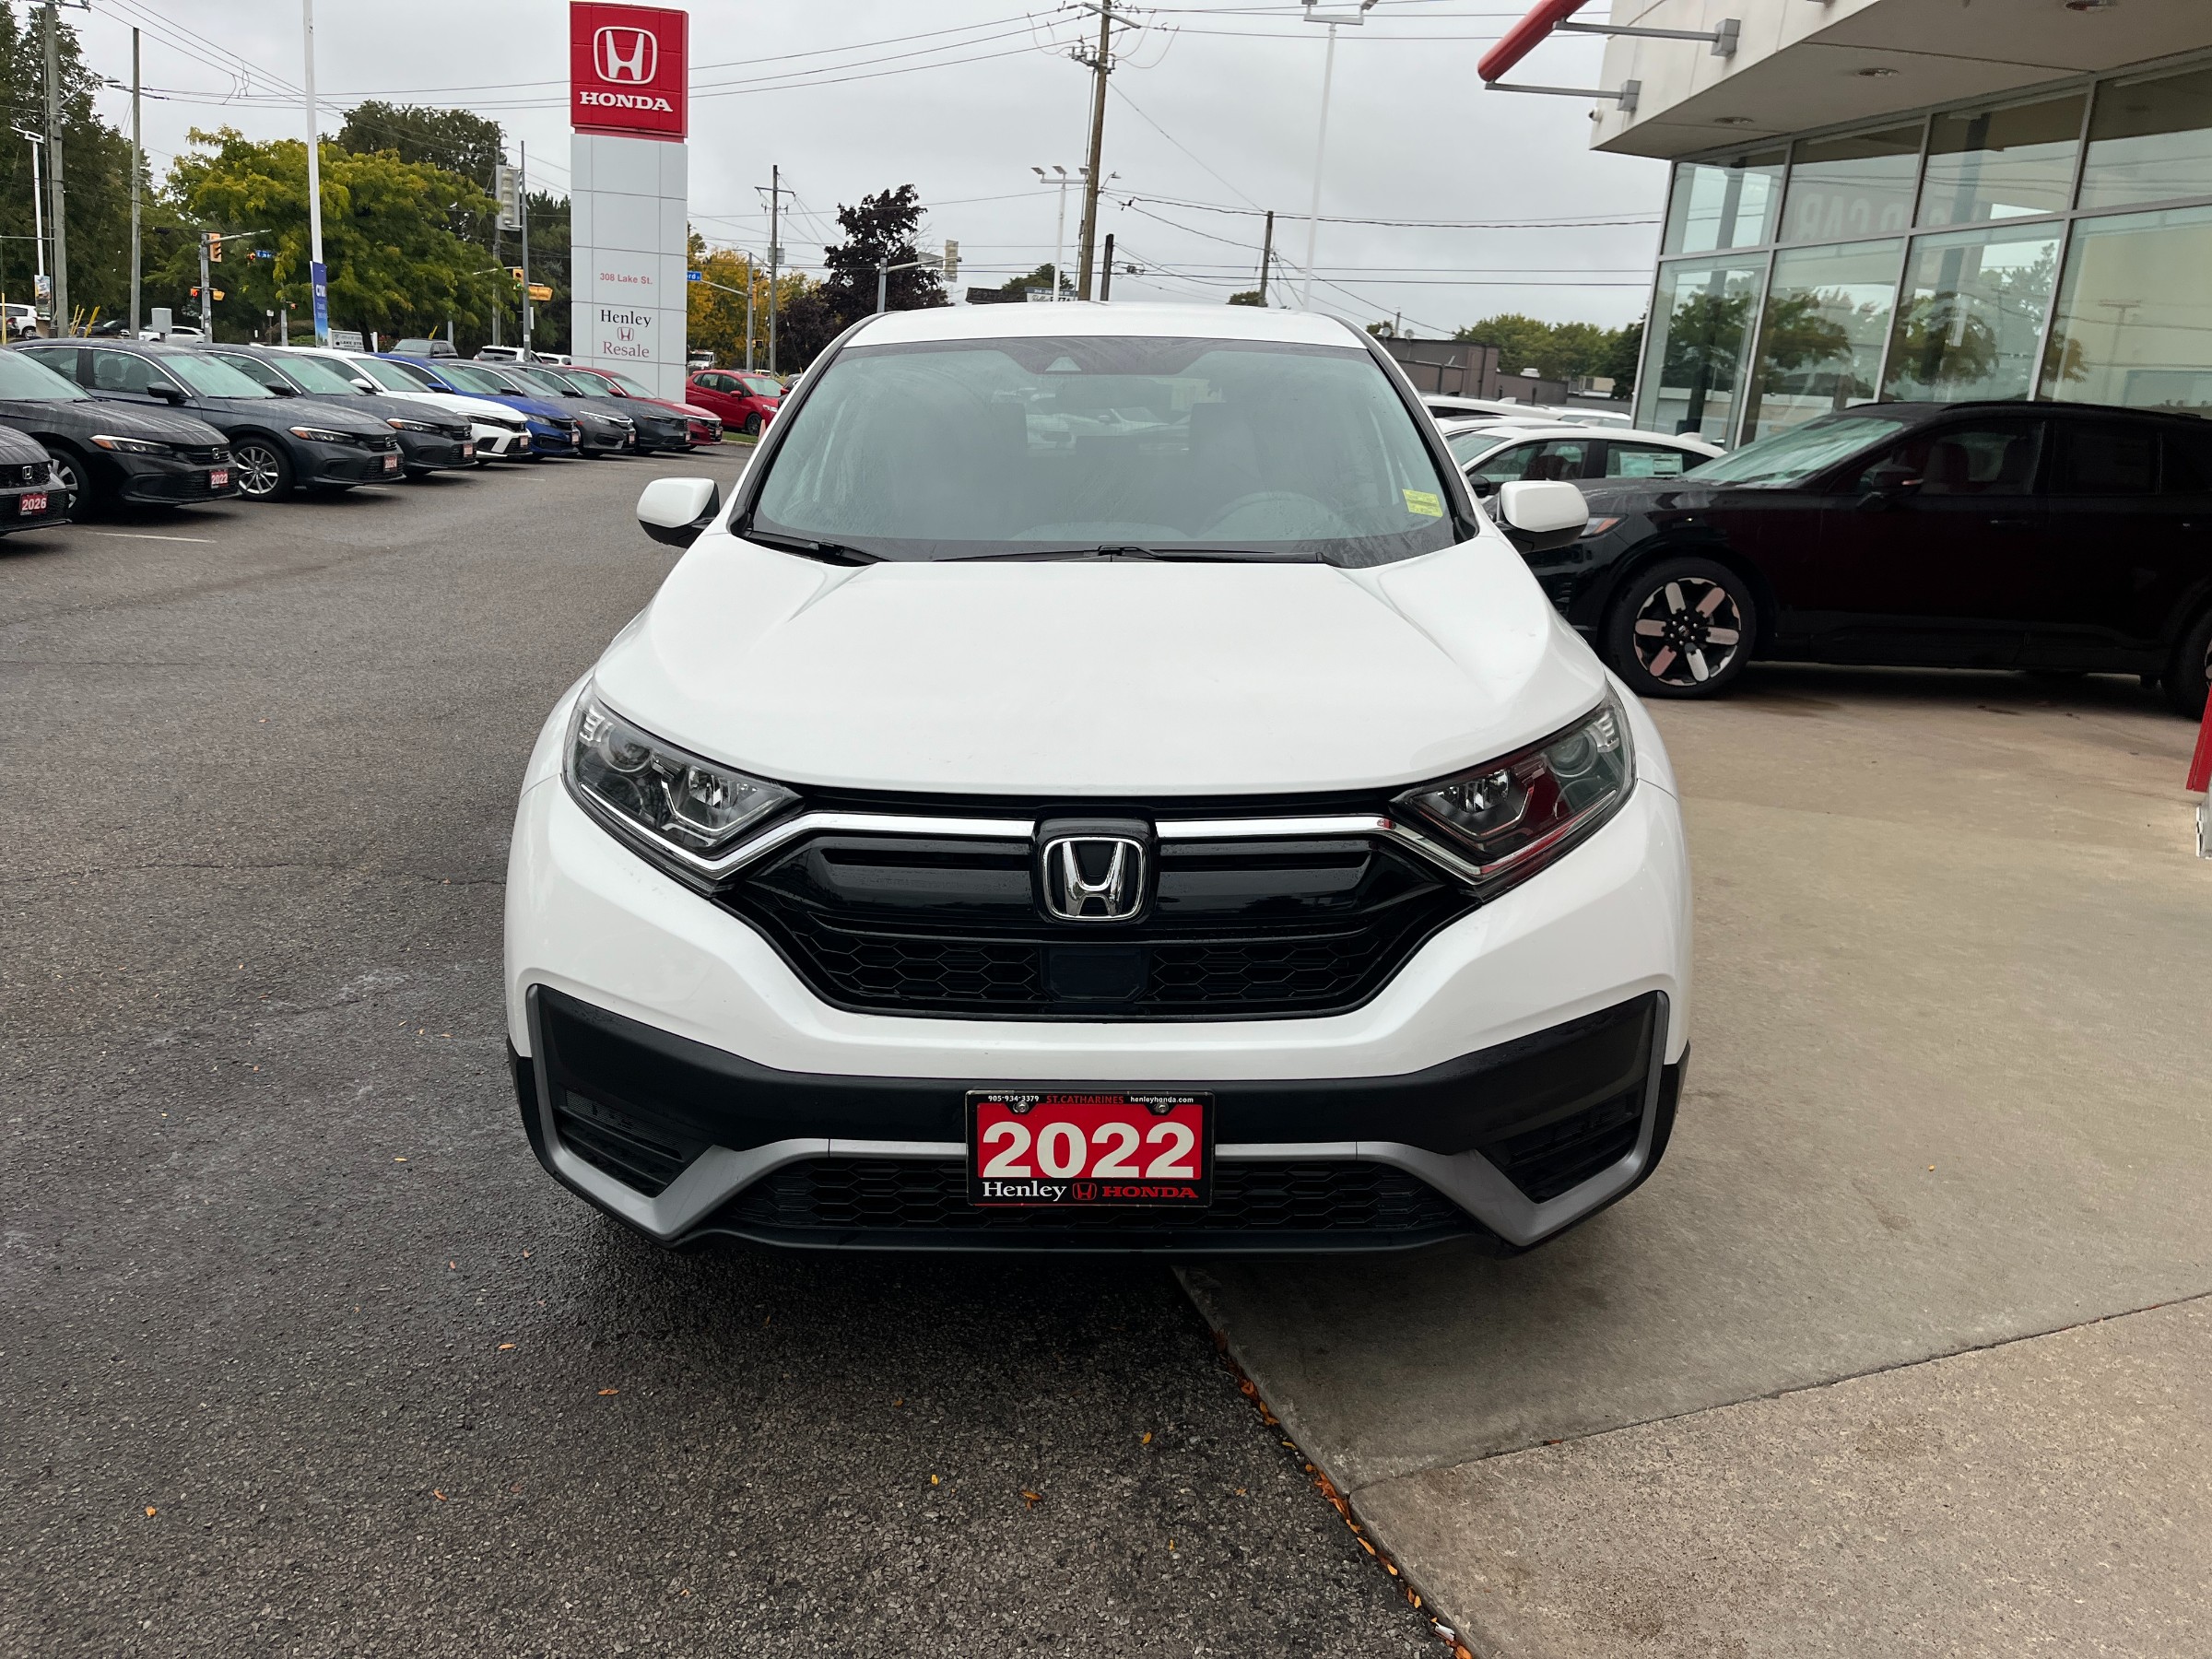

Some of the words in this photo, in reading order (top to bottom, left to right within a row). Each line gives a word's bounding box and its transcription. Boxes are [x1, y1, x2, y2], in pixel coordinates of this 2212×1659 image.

[580, 91, 674, 112] HONDA
[600, 273, 615, 282] 308
[618, 274, 638, 284] Lake
[641, 276, 653, 285] St.
[600, 309, 652, 328] Henley
[603, 340, 650, 358] Resale
[211, 473, 229, 485] 2022
[21, 498, 47, 512] 2026
[1130, 1096, 1194, 1104] henleyhonda.com
[982, 1121, 1195, 1179] 2022
[982, 1180, 1067, 1202] Henley
[1102, 1185, 1199, 1198] HONDA
